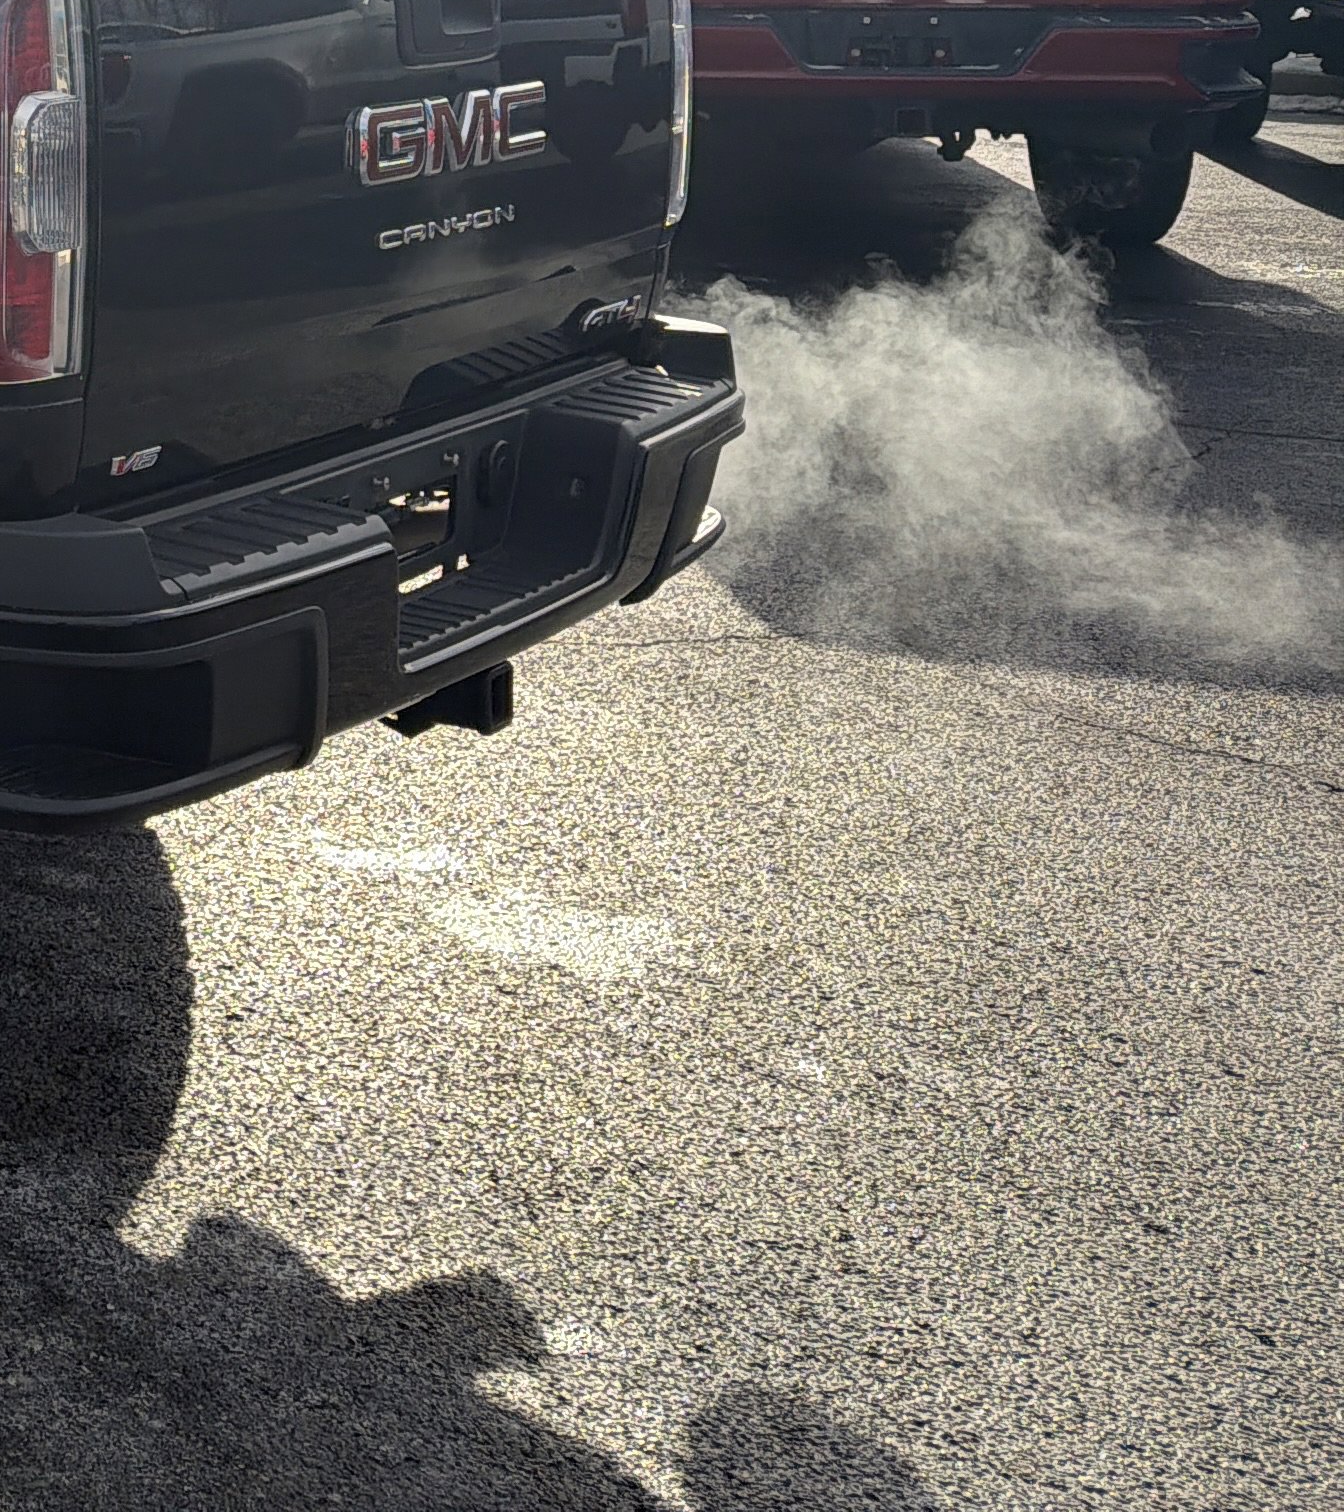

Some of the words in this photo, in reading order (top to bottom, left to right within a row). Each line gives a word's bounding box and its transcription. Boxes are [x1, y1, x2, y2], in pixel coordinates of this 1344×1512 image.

[354, 80, 547, 187] GMC
[378, 204, 515, 250] CANYON
[110, 445, 162, 476] V6
